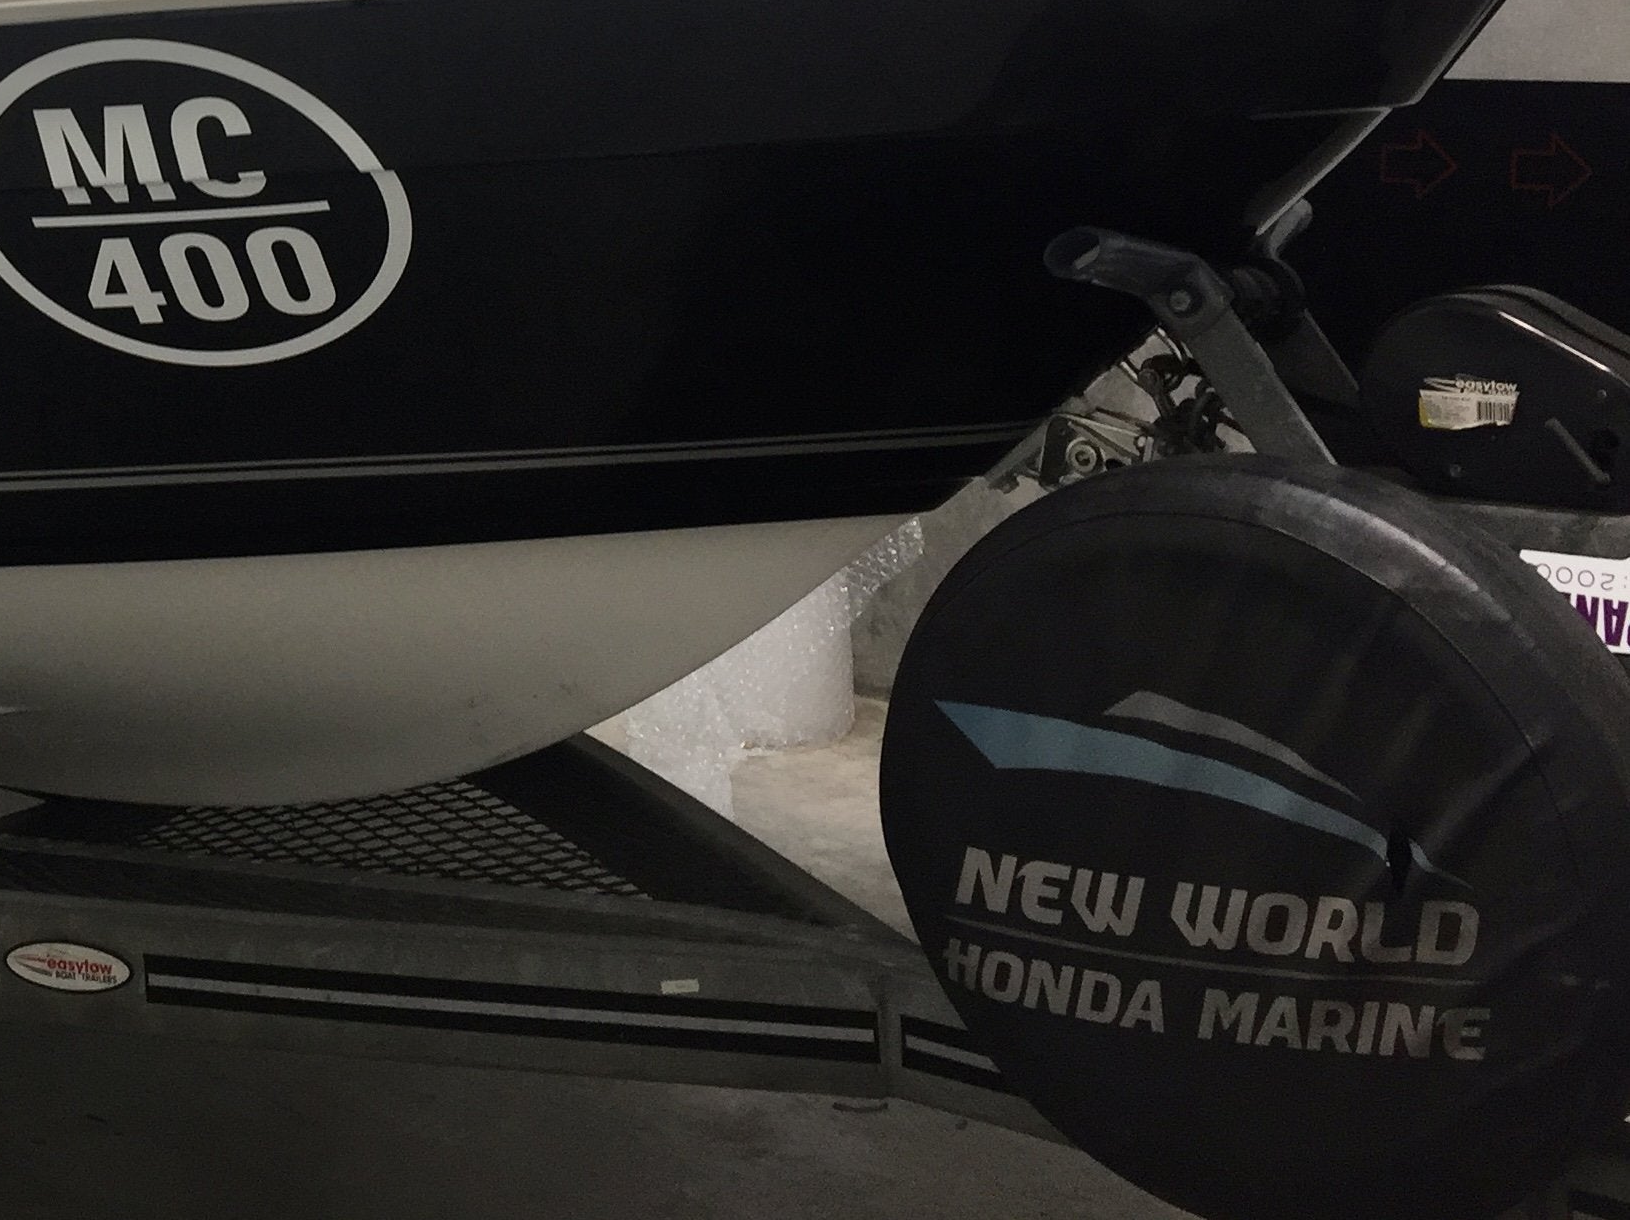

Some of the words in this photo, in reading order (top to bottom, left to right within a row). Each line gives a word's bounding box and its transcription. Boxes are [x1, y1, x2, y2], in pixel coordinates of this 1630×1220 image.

[32, 96, 267, 205] MC
[88, 226, 337, 325] 400
[955, 846, 1145, 937] NEW
[1170, 881, 1480, 966] WORLD
[47, 957, 113, 975] easytow
[944, 938, 1165, 1034] HONDA
[1196, 987, 1491, 1061] MARINE
